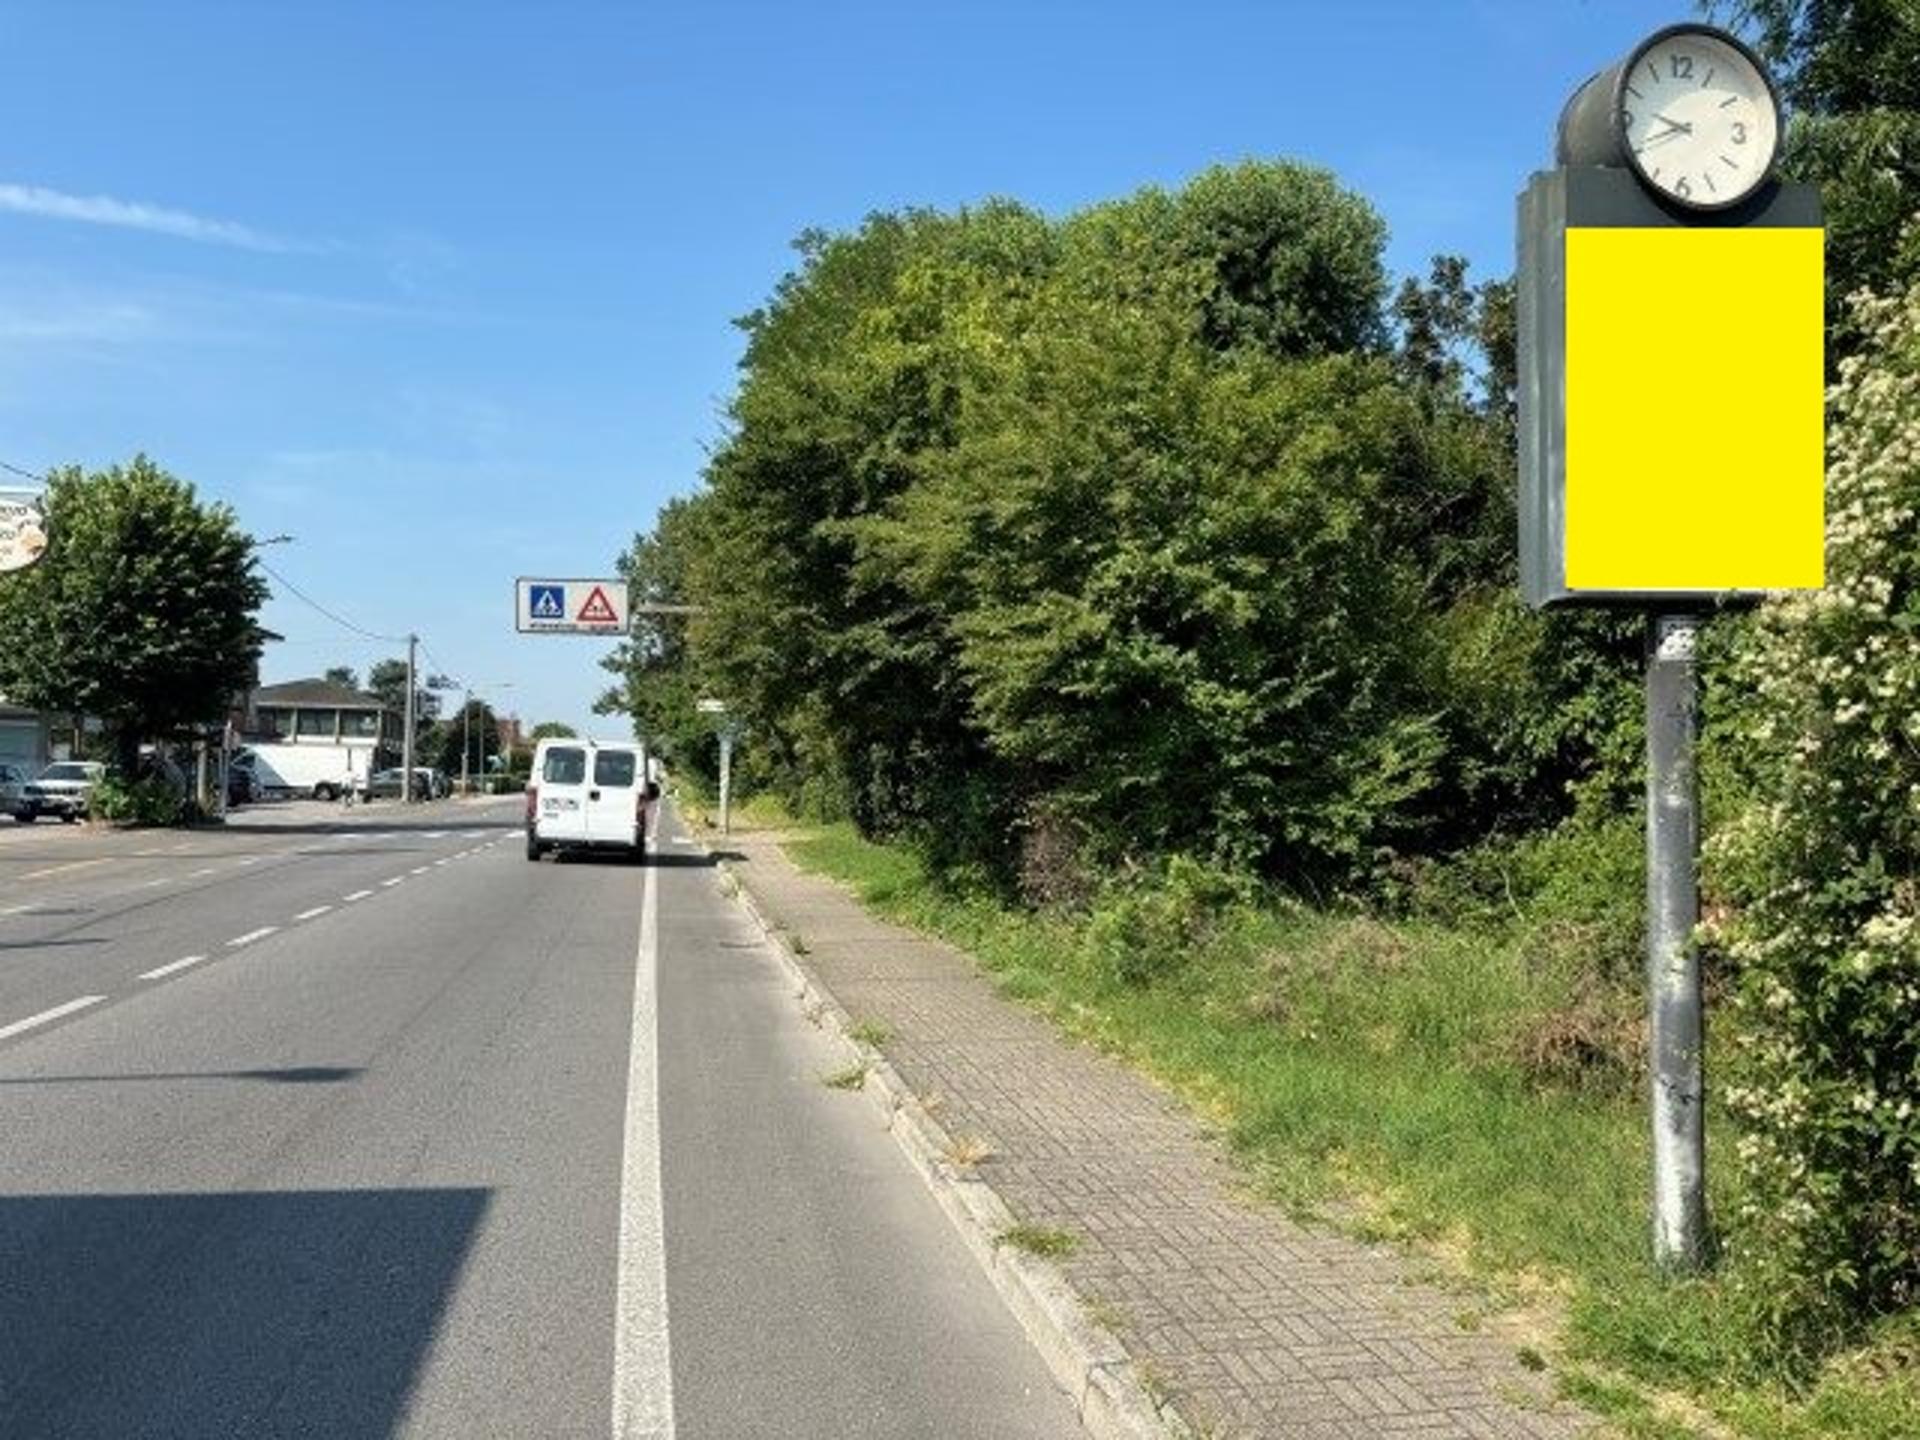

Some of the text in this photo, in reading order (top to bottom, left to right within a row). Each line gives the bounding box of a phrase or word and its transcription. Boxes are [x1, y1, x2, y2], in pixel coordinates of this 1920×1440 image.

[1670, 54, 1694, 79] 12
[1731, 122, 1747, 145] 3
[1674, 176, 1691, 199] 6
